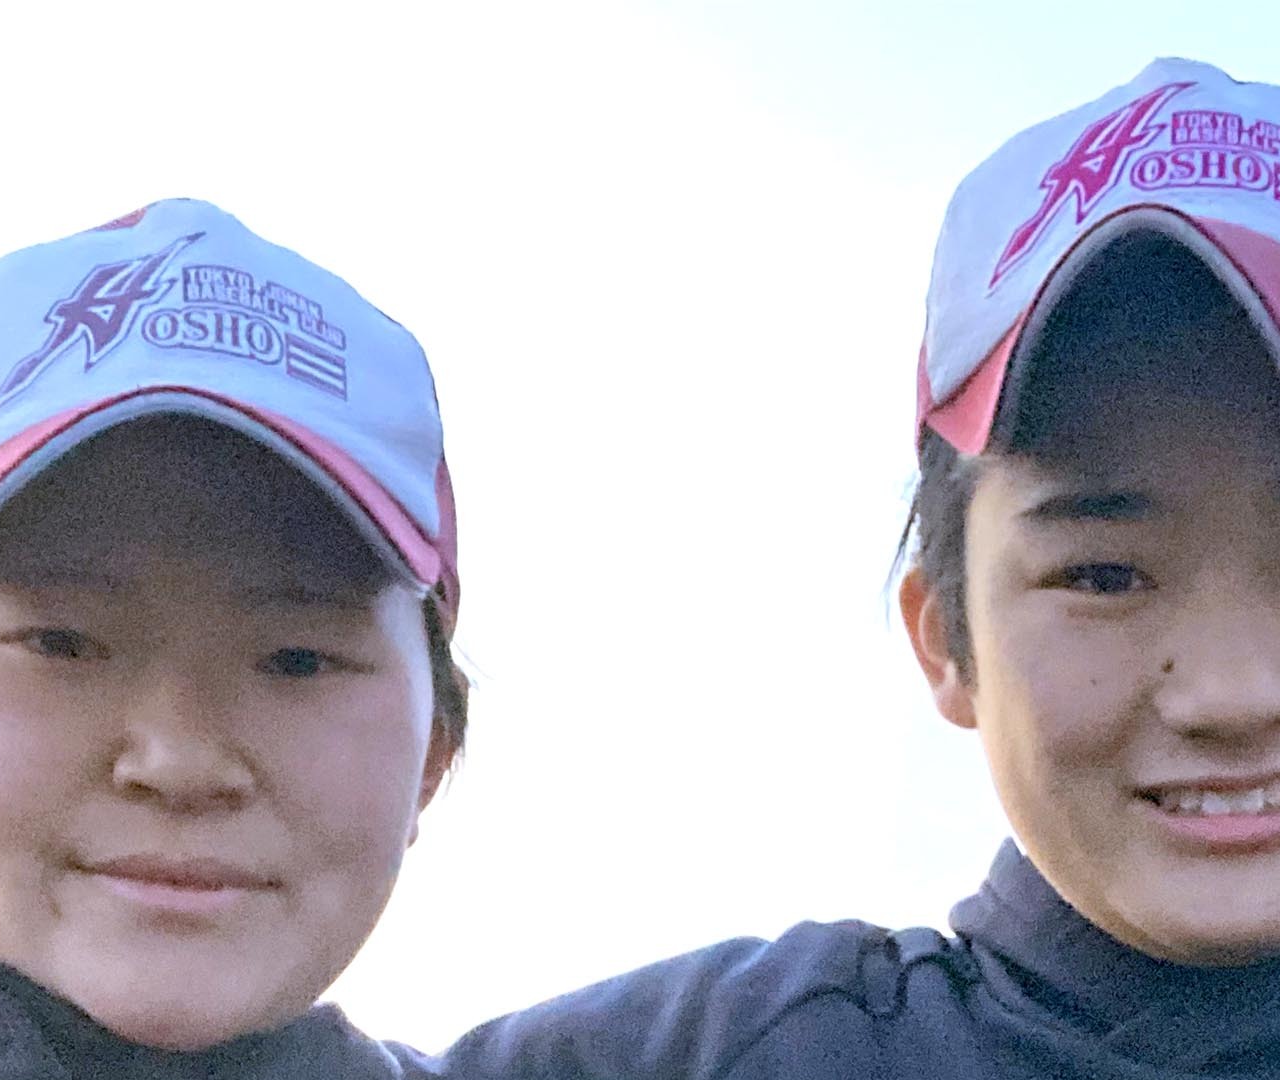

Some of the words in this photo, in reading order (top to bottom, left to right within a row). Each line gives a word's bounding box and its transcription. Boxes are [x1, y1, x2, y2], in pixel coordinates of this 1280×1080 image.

[1177, 113, 1240, 130] TOKYO
[1175, 127, 1275, 154] BASEBALL
[987, 81, 1272, 297] HOSHO
[187, 268, 251, 289] TOKYO
